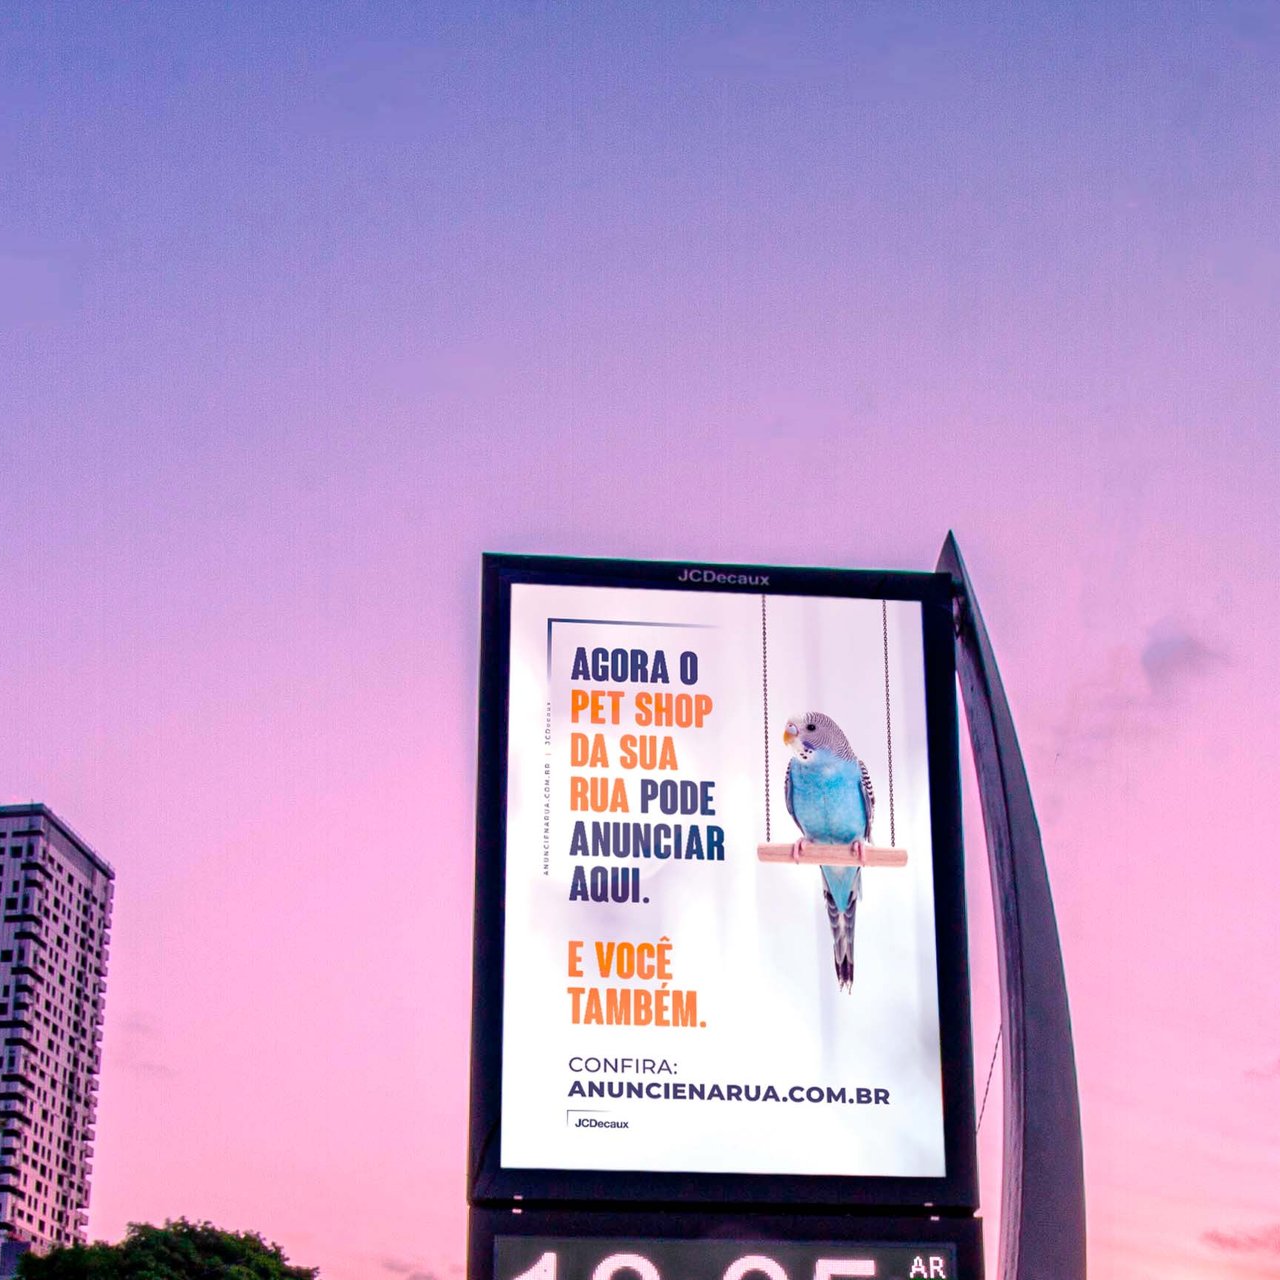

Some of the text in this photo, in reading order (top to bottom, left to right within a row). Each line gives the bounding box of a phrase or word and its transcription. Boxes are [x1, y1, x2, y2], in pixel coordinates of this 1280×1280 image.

[677, 568, 771, 587] JCDecaux
[571, 647, 699, 685] AGORA O
[571, 690, 714, 728] PET SHOP
[570, 733, 678, 771] DA SUA
[570, 776, 716, 816] RUA PODE
[569, 820, 725, 861] ANUNCIAR
[568, 864, 650, 904] AQUI.
[567, 936, 673, 980] E VOCÊ
[567, 983, 708, 1028] TAMBÉM.
[568, 1056, 678, 1075] CONFIRA:
[567, 1080, 891, 1105] ANUNCIENARUA.COM.BR
[574, 1117, 629, 1131] JCDecaux
[909, 1255, 947, 1280] AR
